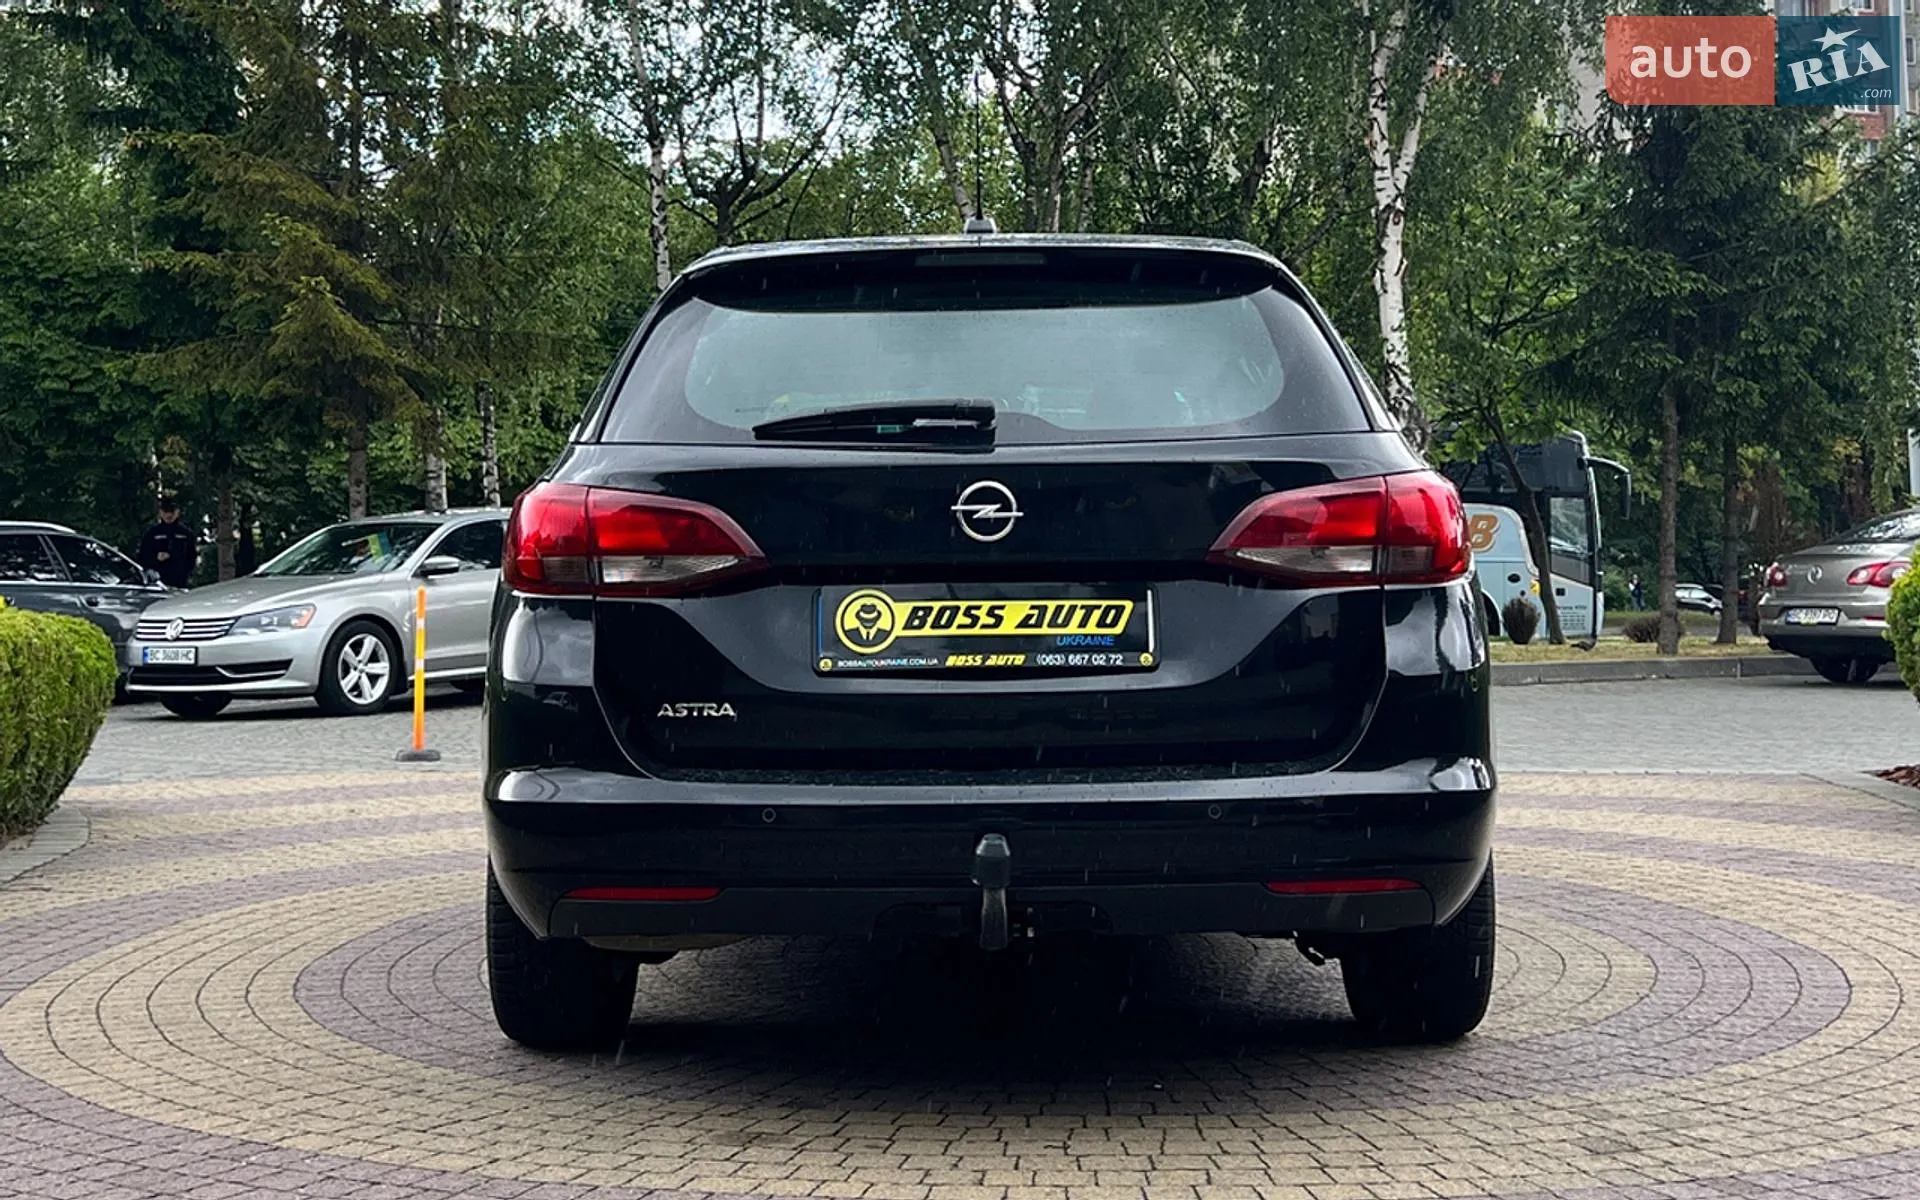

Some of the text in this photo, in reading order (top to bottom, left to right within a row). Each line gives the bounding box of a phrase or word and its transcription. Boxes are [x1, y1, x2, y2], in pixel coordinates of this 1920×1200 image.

[901, 603, 1127, 631] BOSS AUTO
[1055, 635, 1116, 647] UKRAINE
[837, 657, 939, 668] BOSSAUTOUKRAINE.COM.UA
[945, 653, 1027, 667] BOSS AUTO
[1068, 653, 1089, 666] 667
[1091, 653, 1107, 666] 02
[1107, 653, 1124, 666] 72
[656, 702, 736, 718] ASTRA
